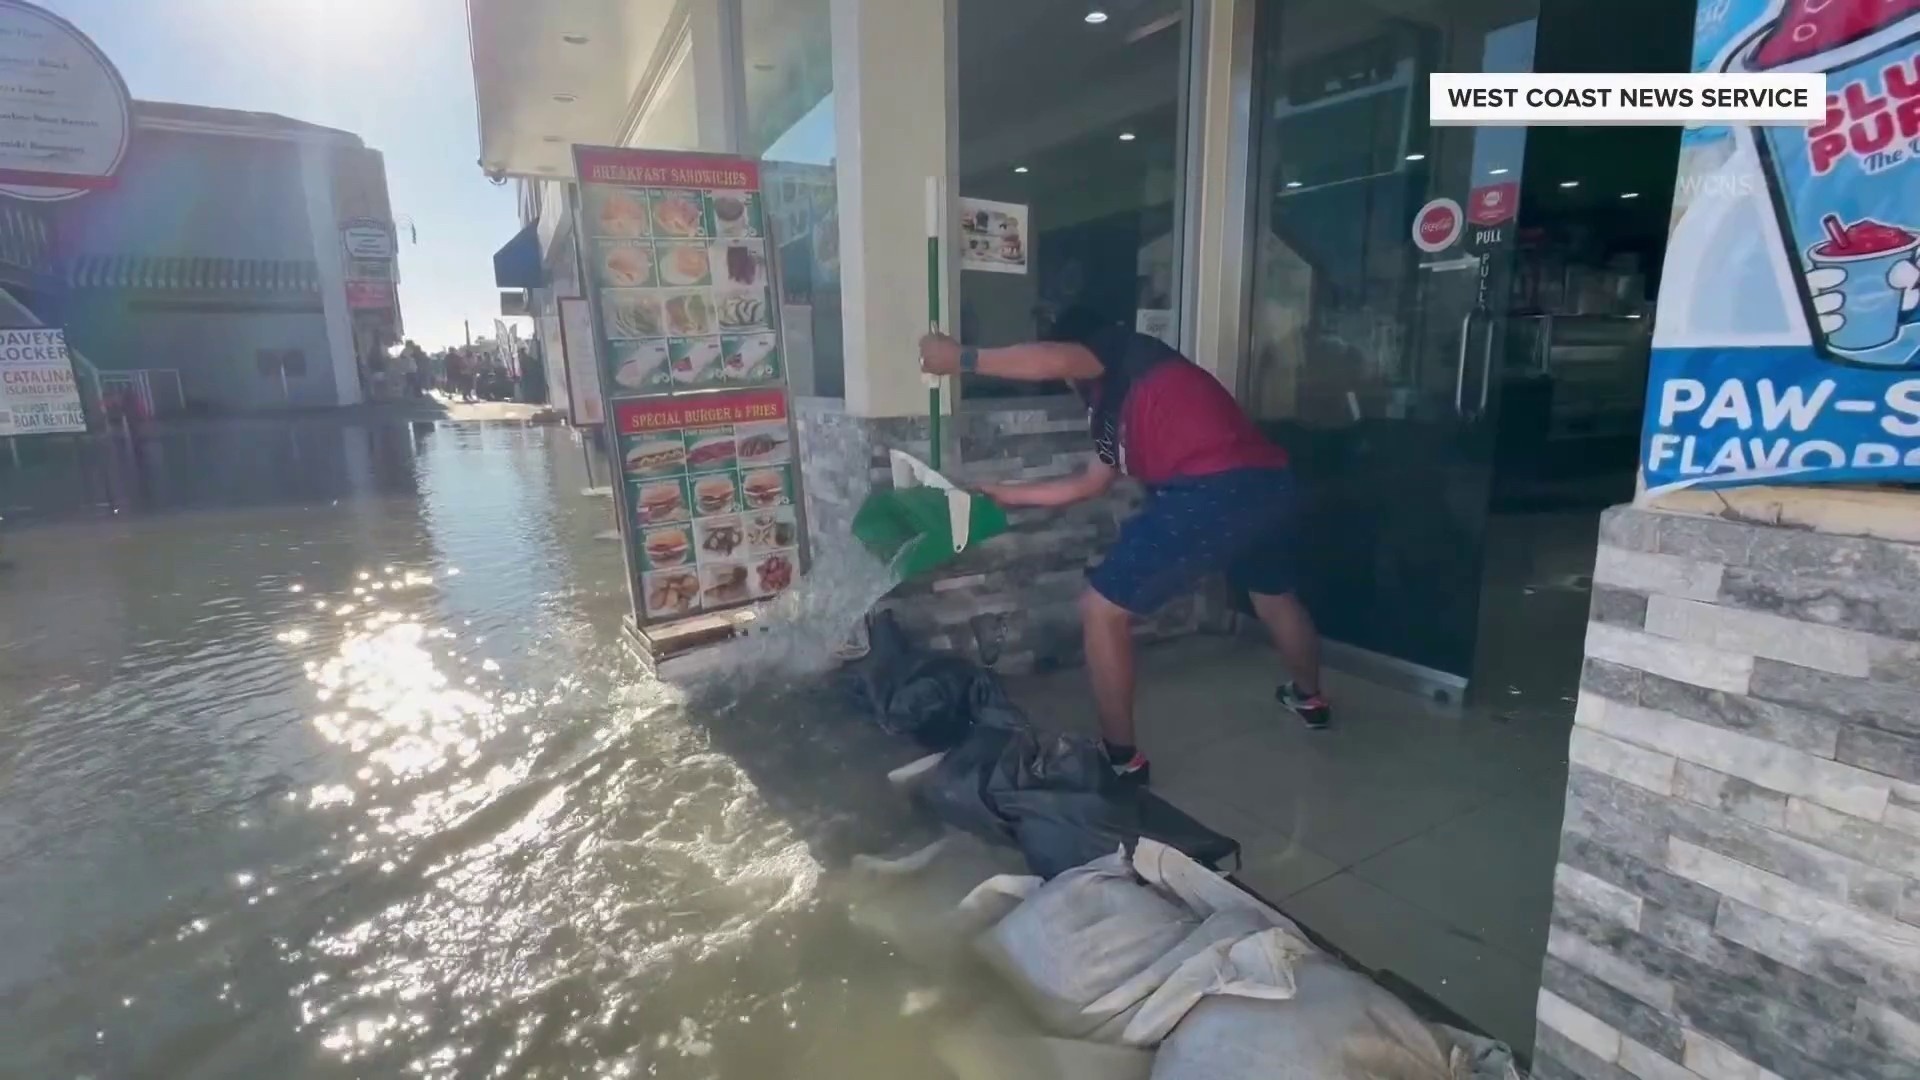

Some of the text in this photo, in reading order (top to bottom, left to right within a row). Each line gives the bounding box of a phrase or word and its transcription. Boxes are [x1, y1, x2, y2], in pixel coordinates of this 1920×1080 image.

[592, 164, 747, 187] BREAKFAST SANDWICHES
[1476, 230, 1502, 245] PULL
[2, 370, 73, 384] CATALINA
[43, 411, 86, 426] RENTALS
[631, 412, 681, 428] SPECIAL
[684, 408, 732, 424] BURGER
[745, 403, 777, 418] FRIES
